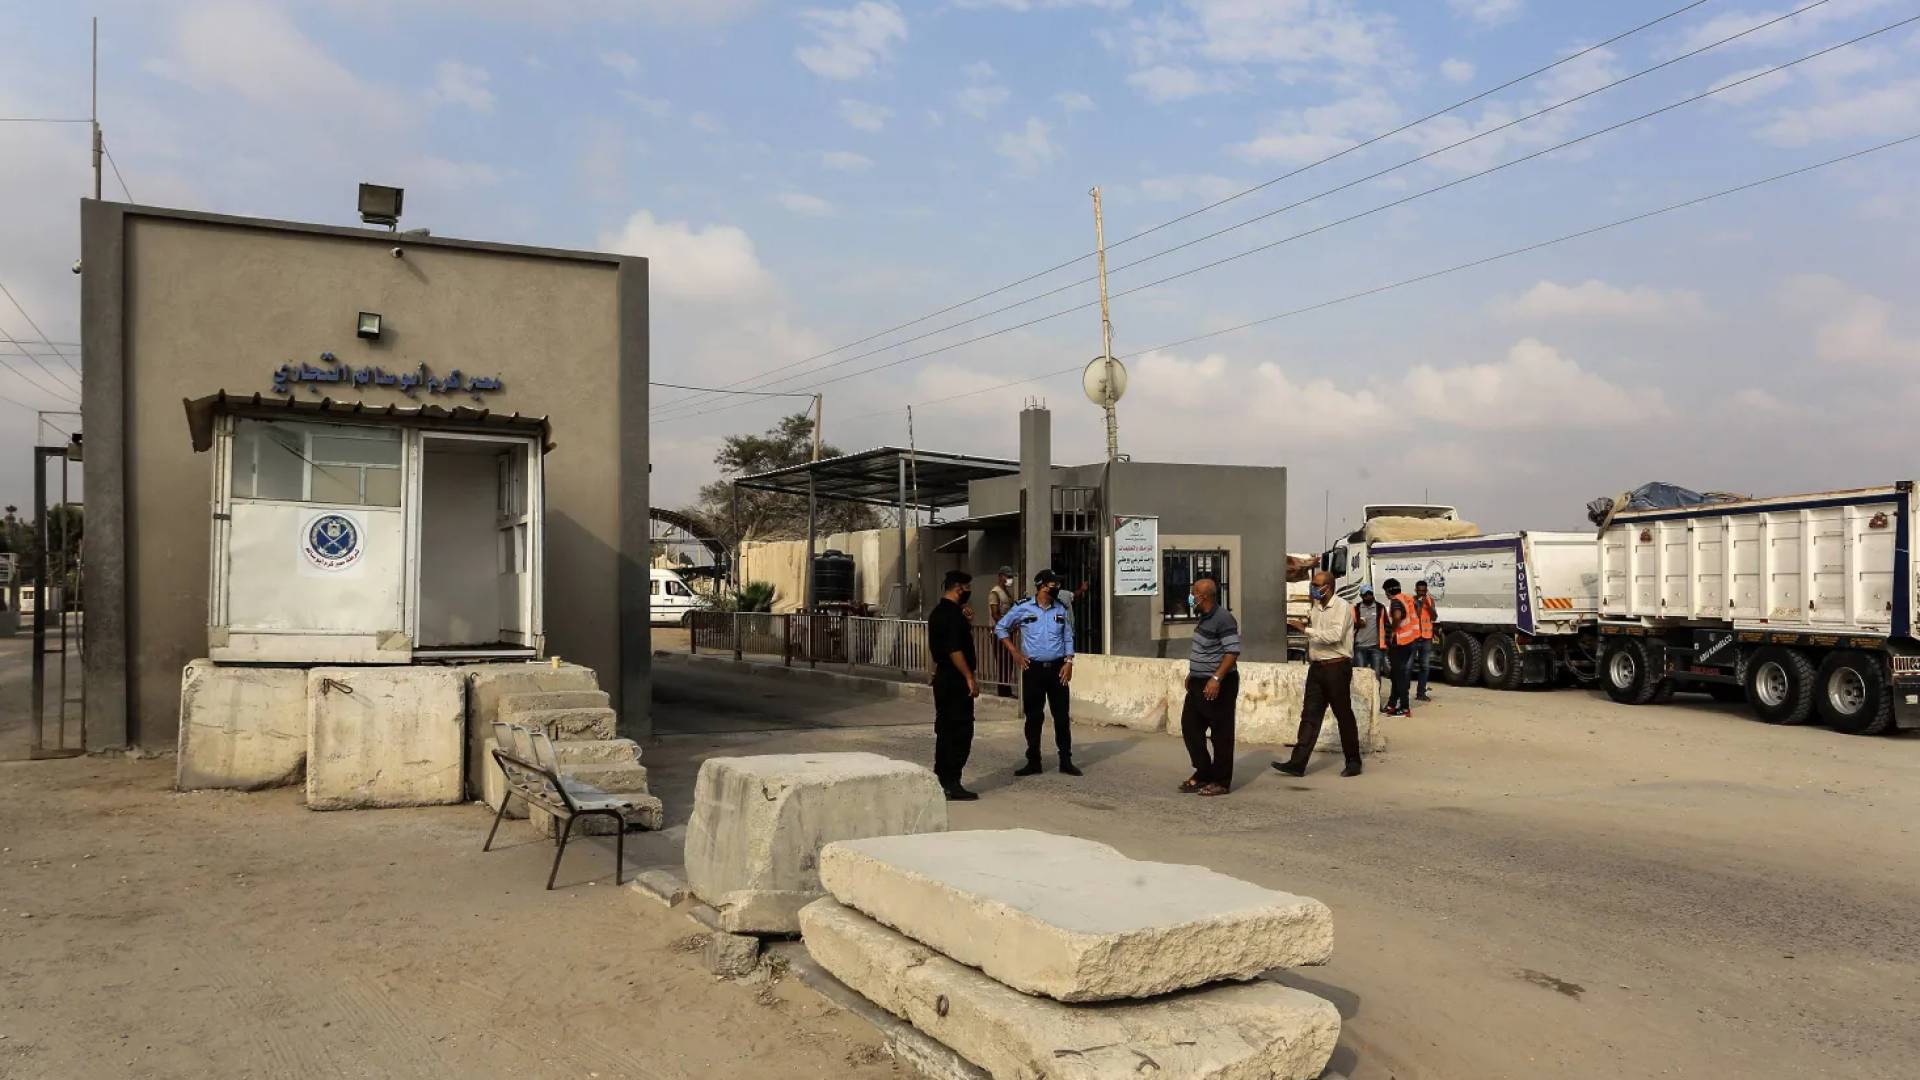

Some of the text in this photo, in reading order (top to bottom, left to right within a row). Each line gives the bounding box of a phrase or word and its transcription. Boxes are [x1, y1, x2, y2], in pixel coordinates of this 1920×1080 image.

[272, 352, 503, 401] معبر كرم أبو سالم التجاري
[1517, 562, 1528, 613] VOLVO
